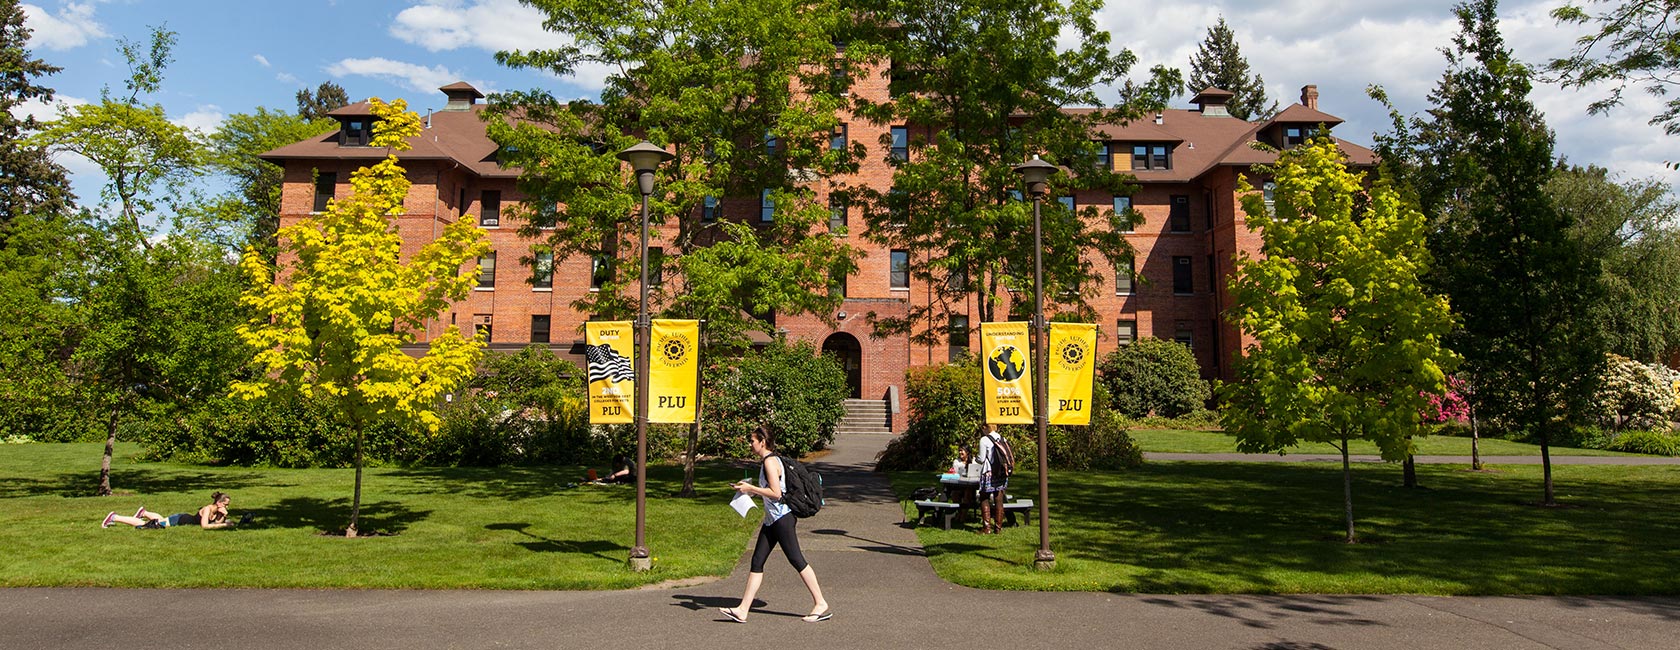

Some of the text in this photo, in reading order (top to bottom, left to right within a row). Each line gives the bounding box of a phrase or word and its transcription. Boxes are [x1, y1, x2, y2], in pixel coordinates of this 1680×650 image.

[672, 332, 692, 352] LUTHERAN
[1070, 336, 1090, 355] LUTHERAN
[997, 387, 1021, 395] 50%
[658, 396, 686, 408] PLU
[1058, 399, 1083, 412] PLU
[602, 406, 621, 415] PLU
[999, 406, 1020, 416] PLU
